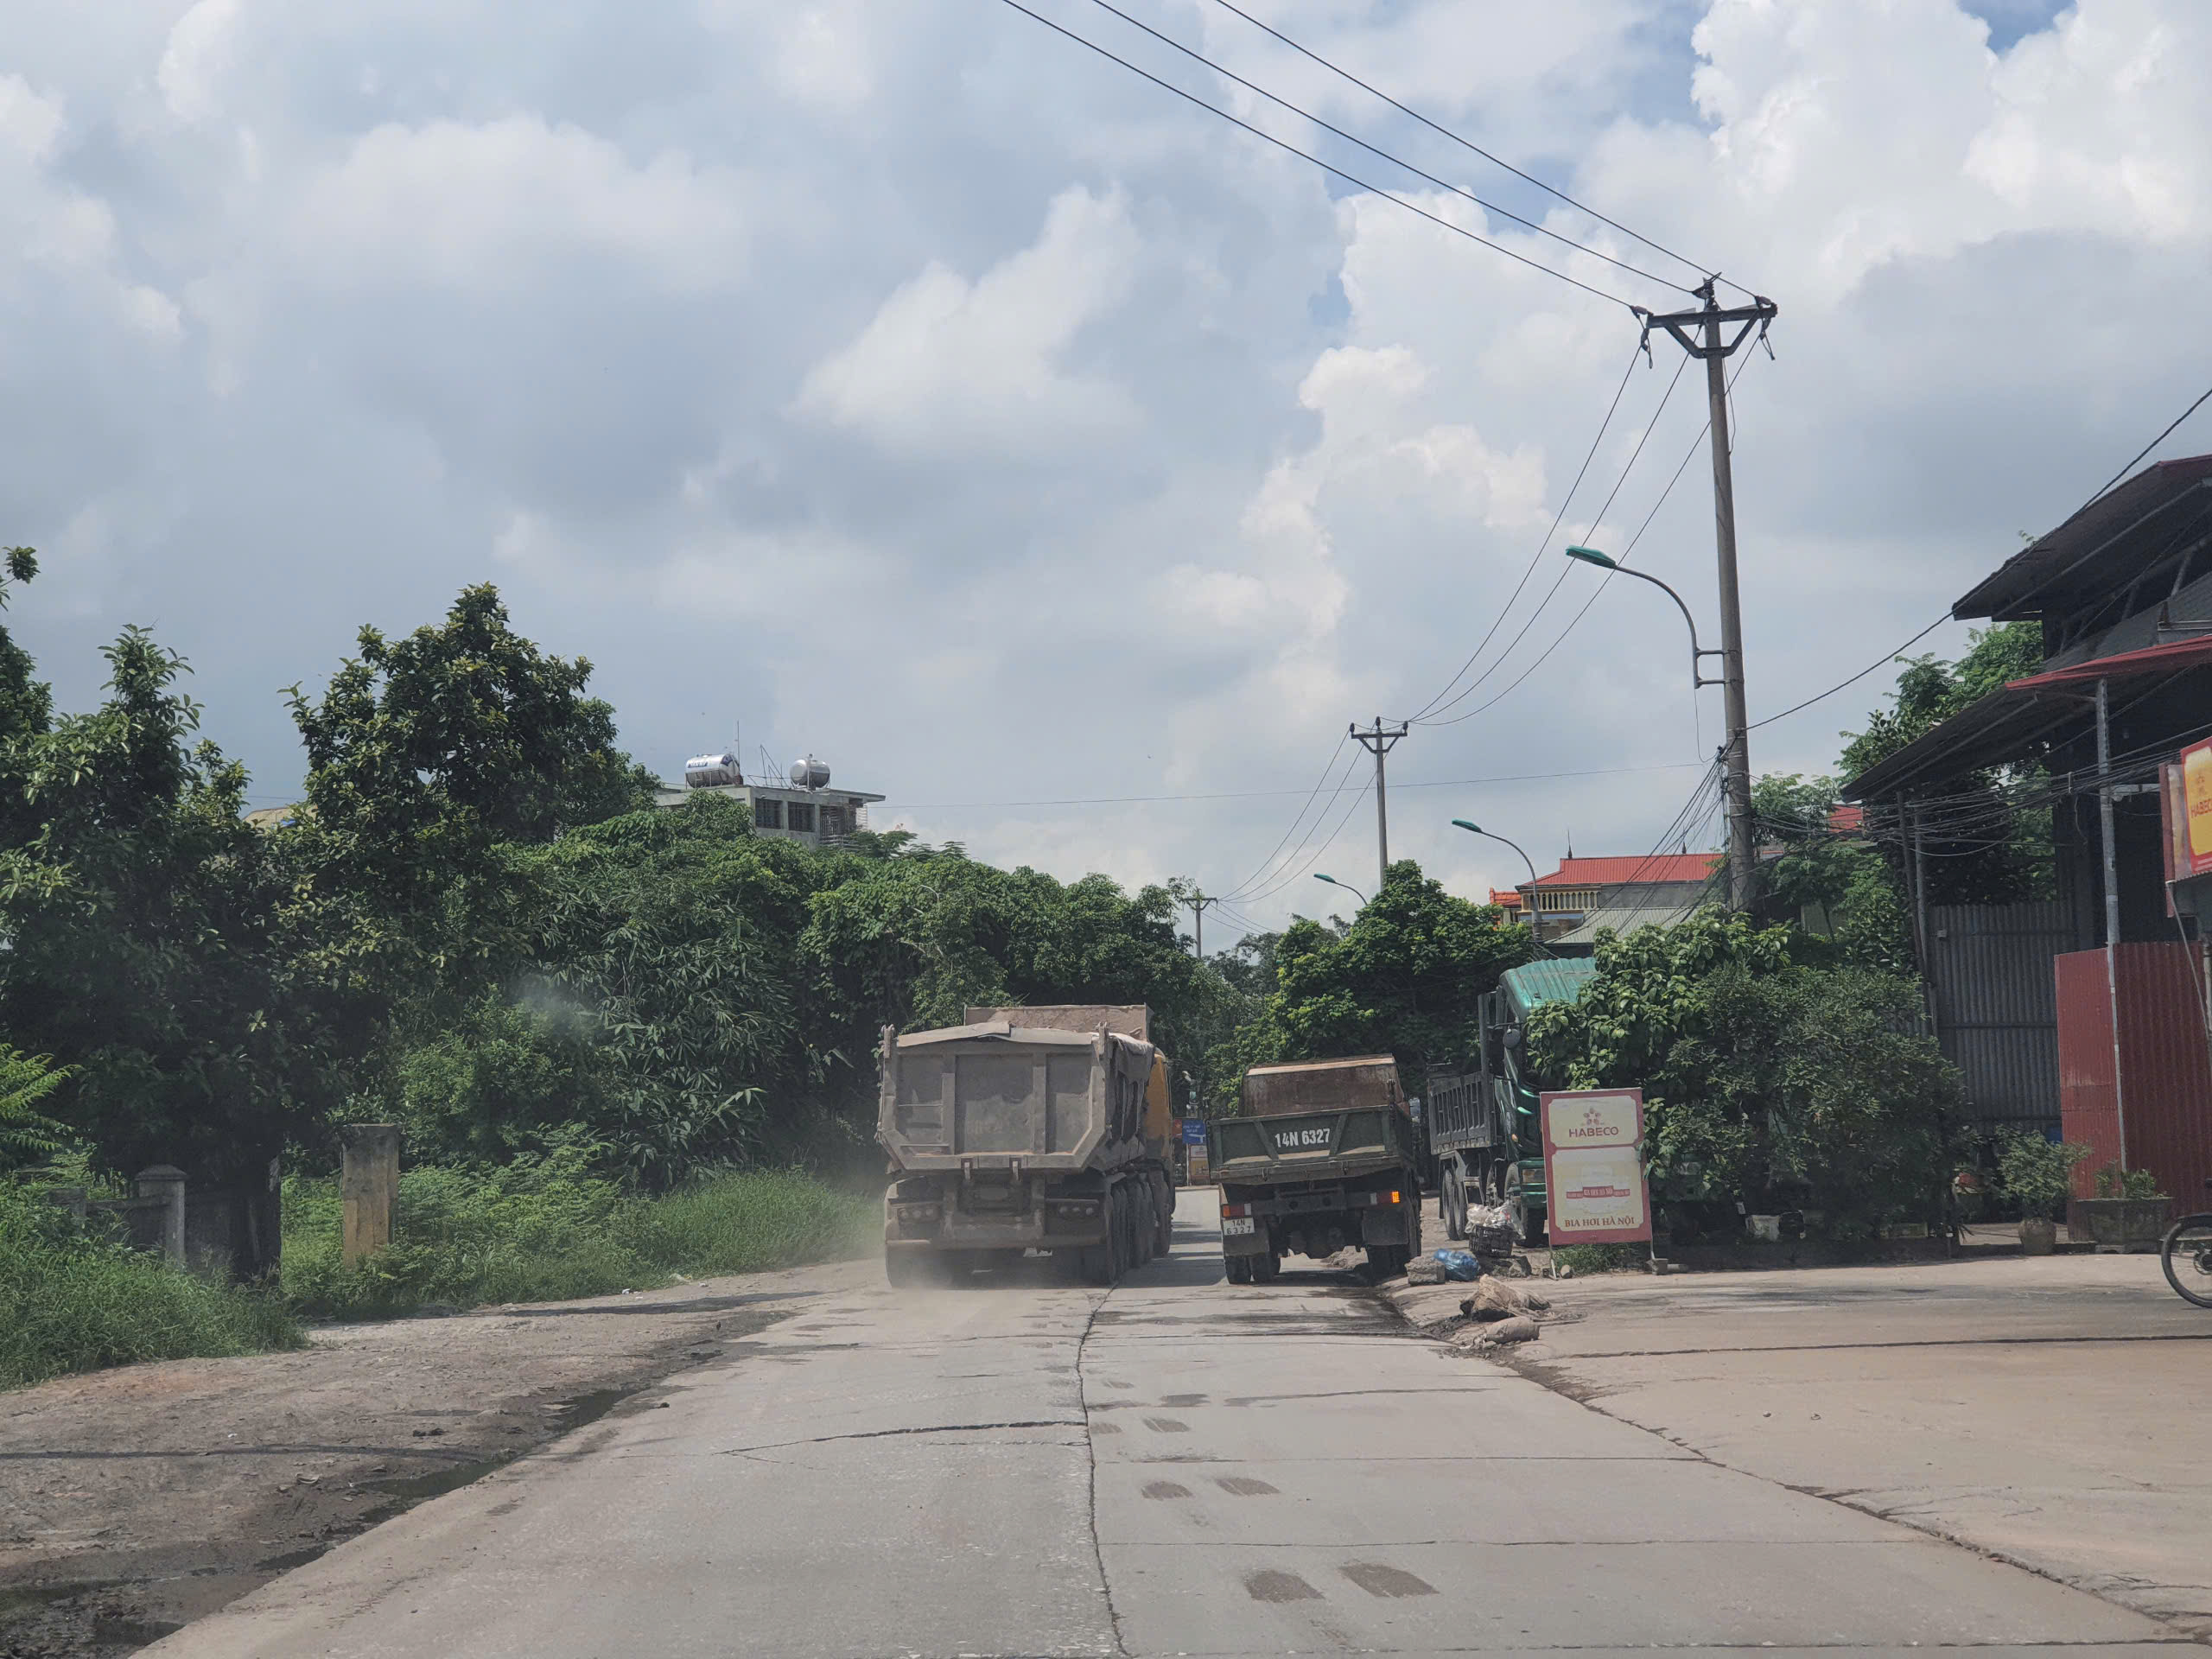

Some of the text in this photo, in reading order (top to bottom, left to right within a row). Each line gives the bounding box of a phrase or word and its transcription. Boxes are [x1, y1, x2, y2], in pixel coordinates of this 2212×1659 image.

[1274, 1128, 1331, 1147] 14N 6327
[1568, 1126, 1619, 1138] HABECO
[1565, 1219, 1580, 1228] BIA
[1602, 1216, 1616, 1226] HÀ
[1227, 1225, 1251, 1235] 6327
